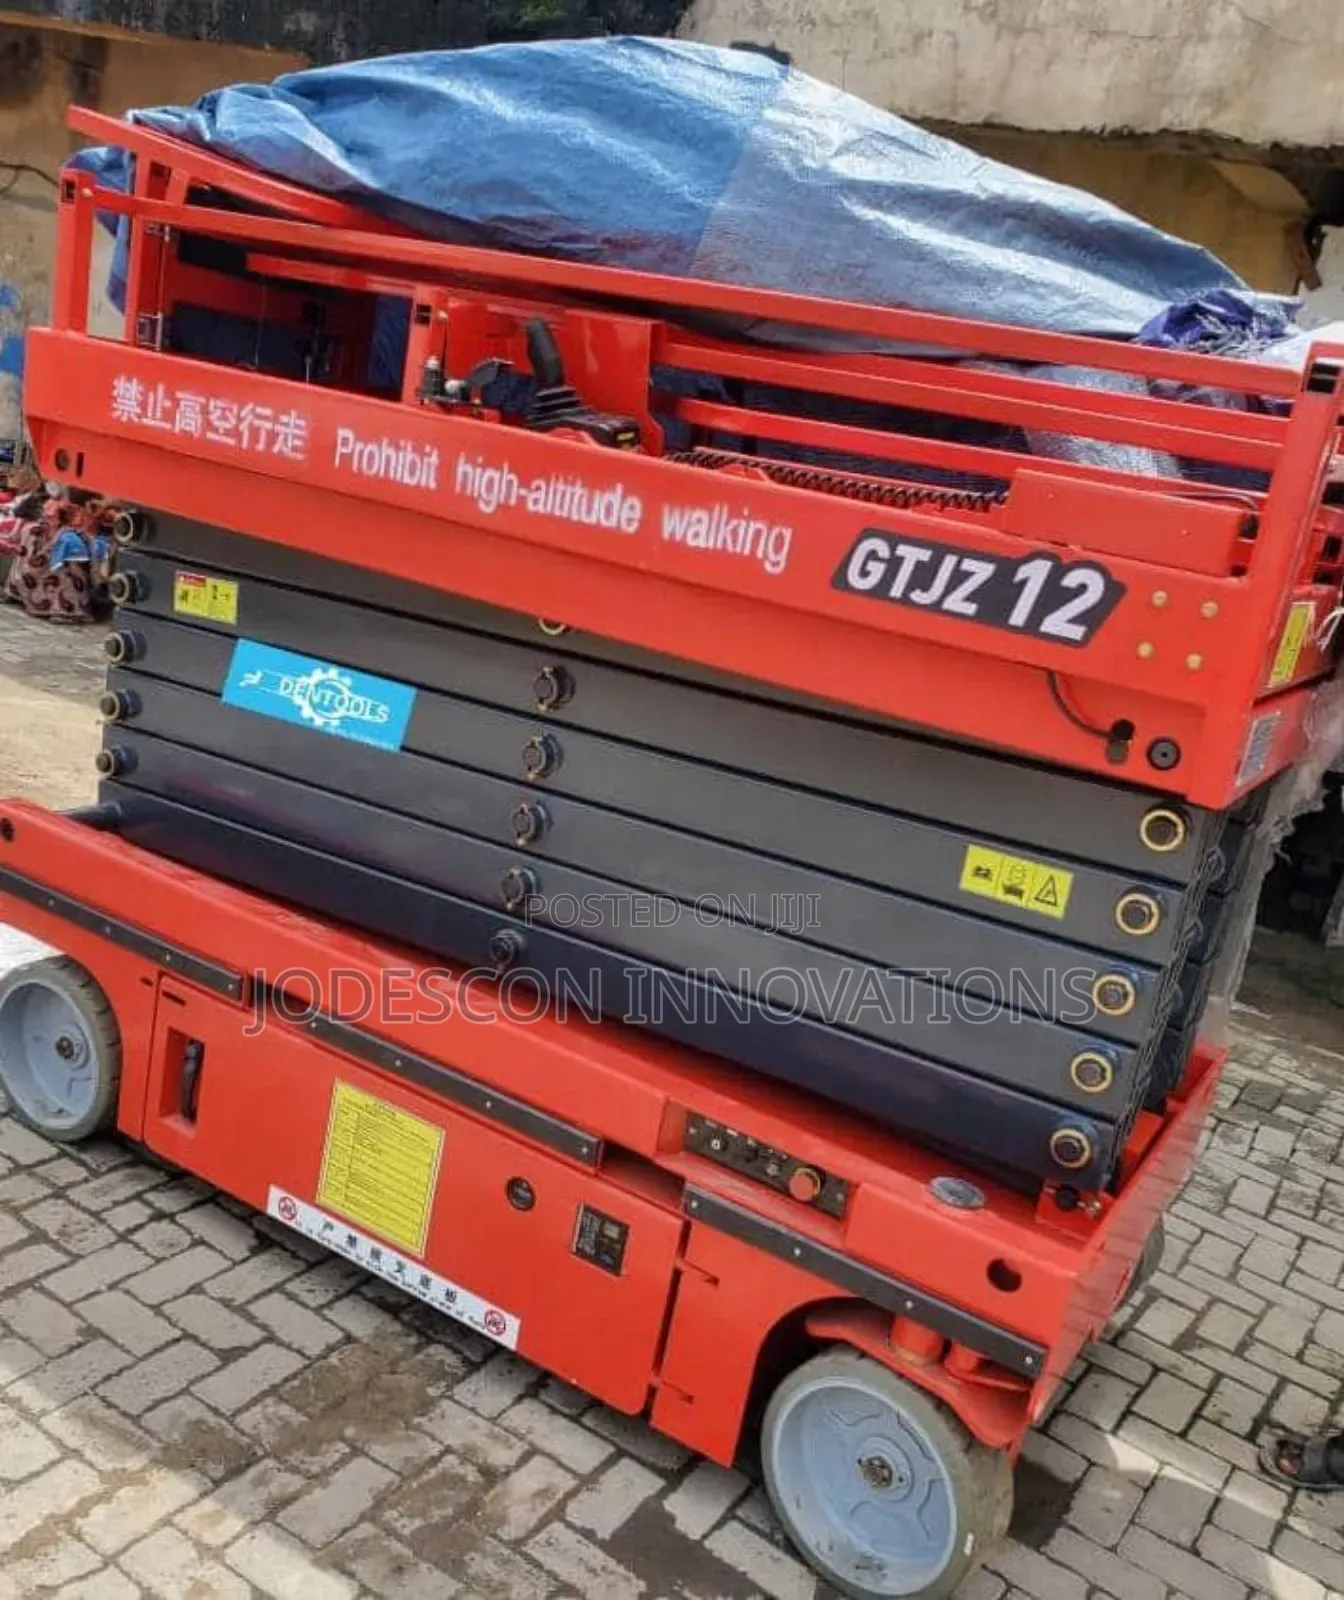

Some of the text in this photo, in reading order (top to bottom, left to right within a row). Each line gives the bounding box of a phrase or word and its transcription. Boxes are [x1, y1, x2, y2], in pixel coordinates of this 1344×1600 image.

[111, 373, 307, 460] 禁止高空行走
[334, 427, 792, 575] Prohibit high-altitude walking
[846, 536, 1105, 641] GTJZ 12
[279, 677, 391, 723] DENTOOLS
